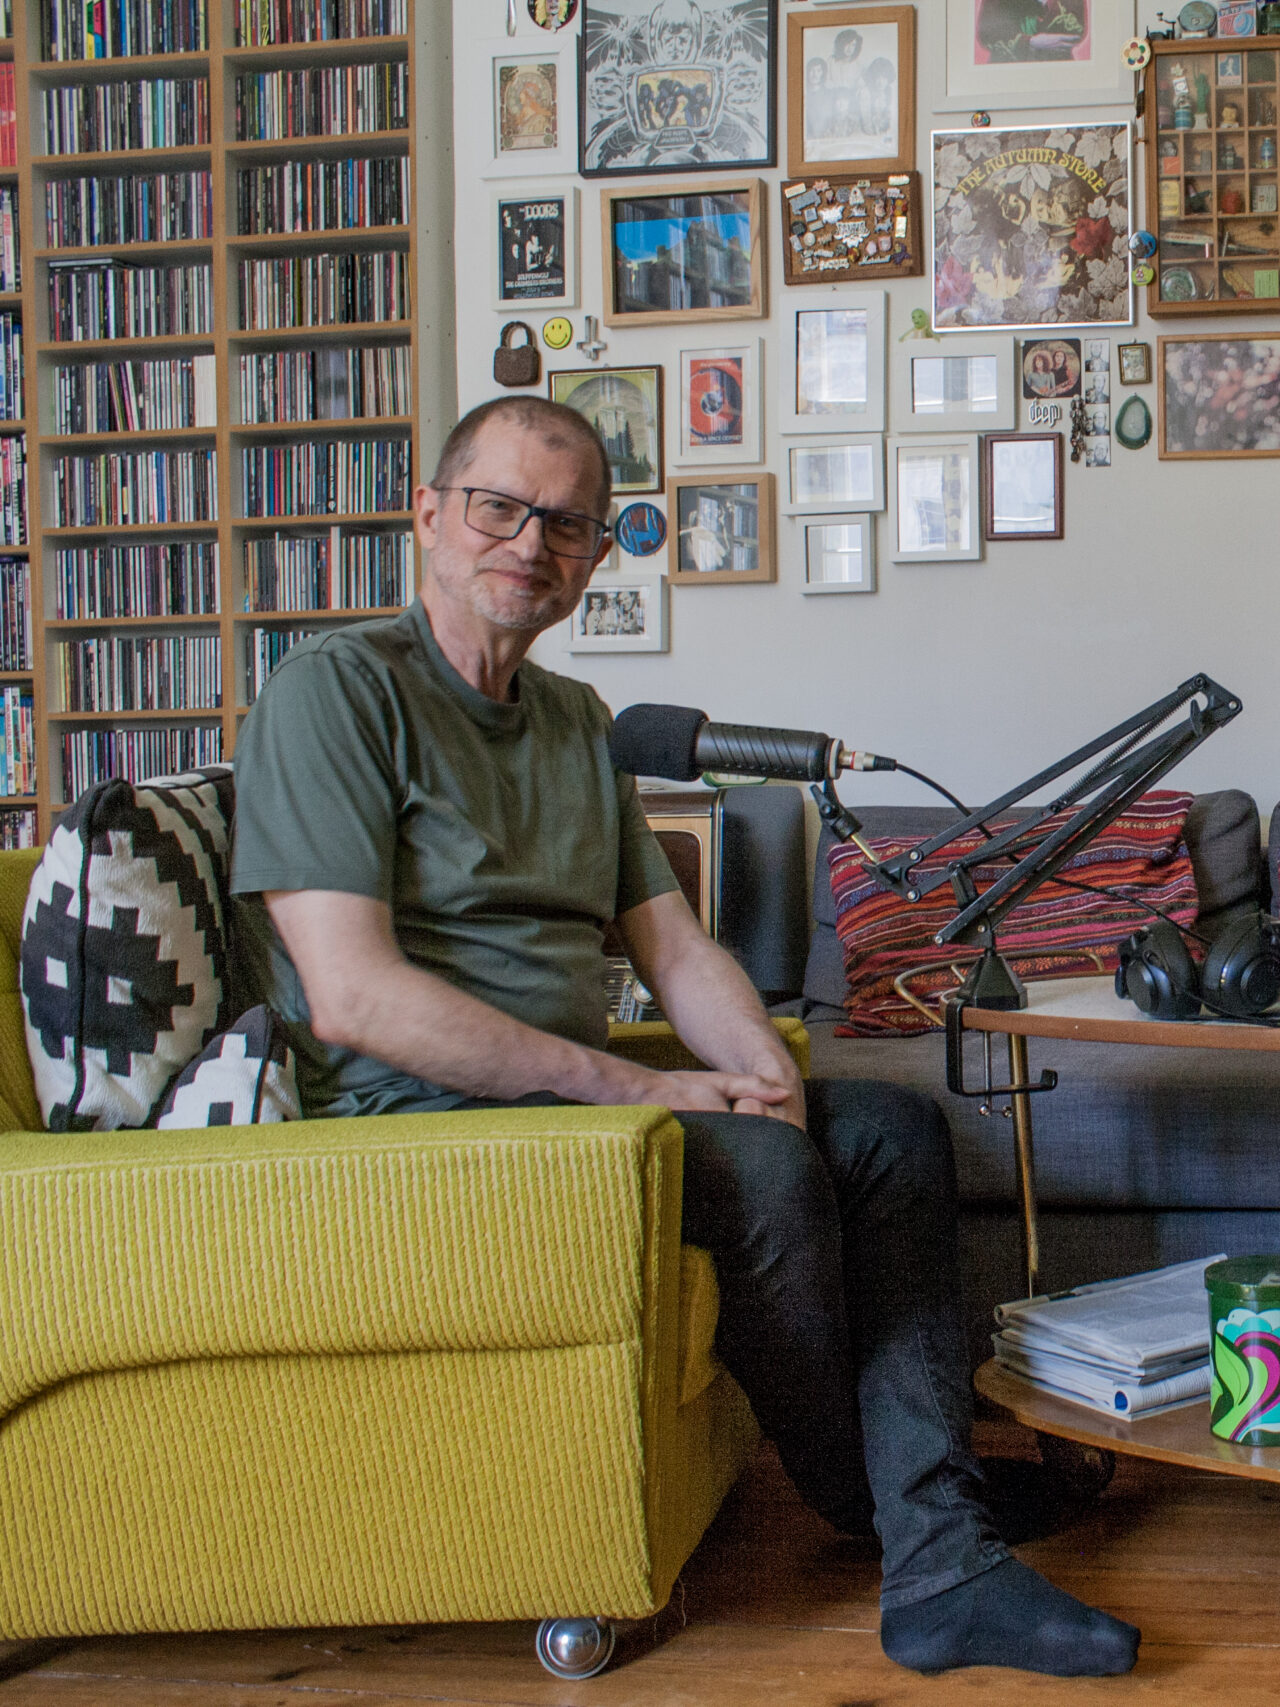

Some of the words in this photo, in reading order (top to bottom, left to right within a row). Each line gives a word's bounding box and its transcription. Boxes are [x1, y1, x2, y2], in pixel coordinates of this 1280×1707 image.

[954, 166, 987, 196] THE
[984, 148, 1058, 175] AUTUMN
[1058, 153, 1107, 194] STONE
[524, 203, 559, 220] DOORS
